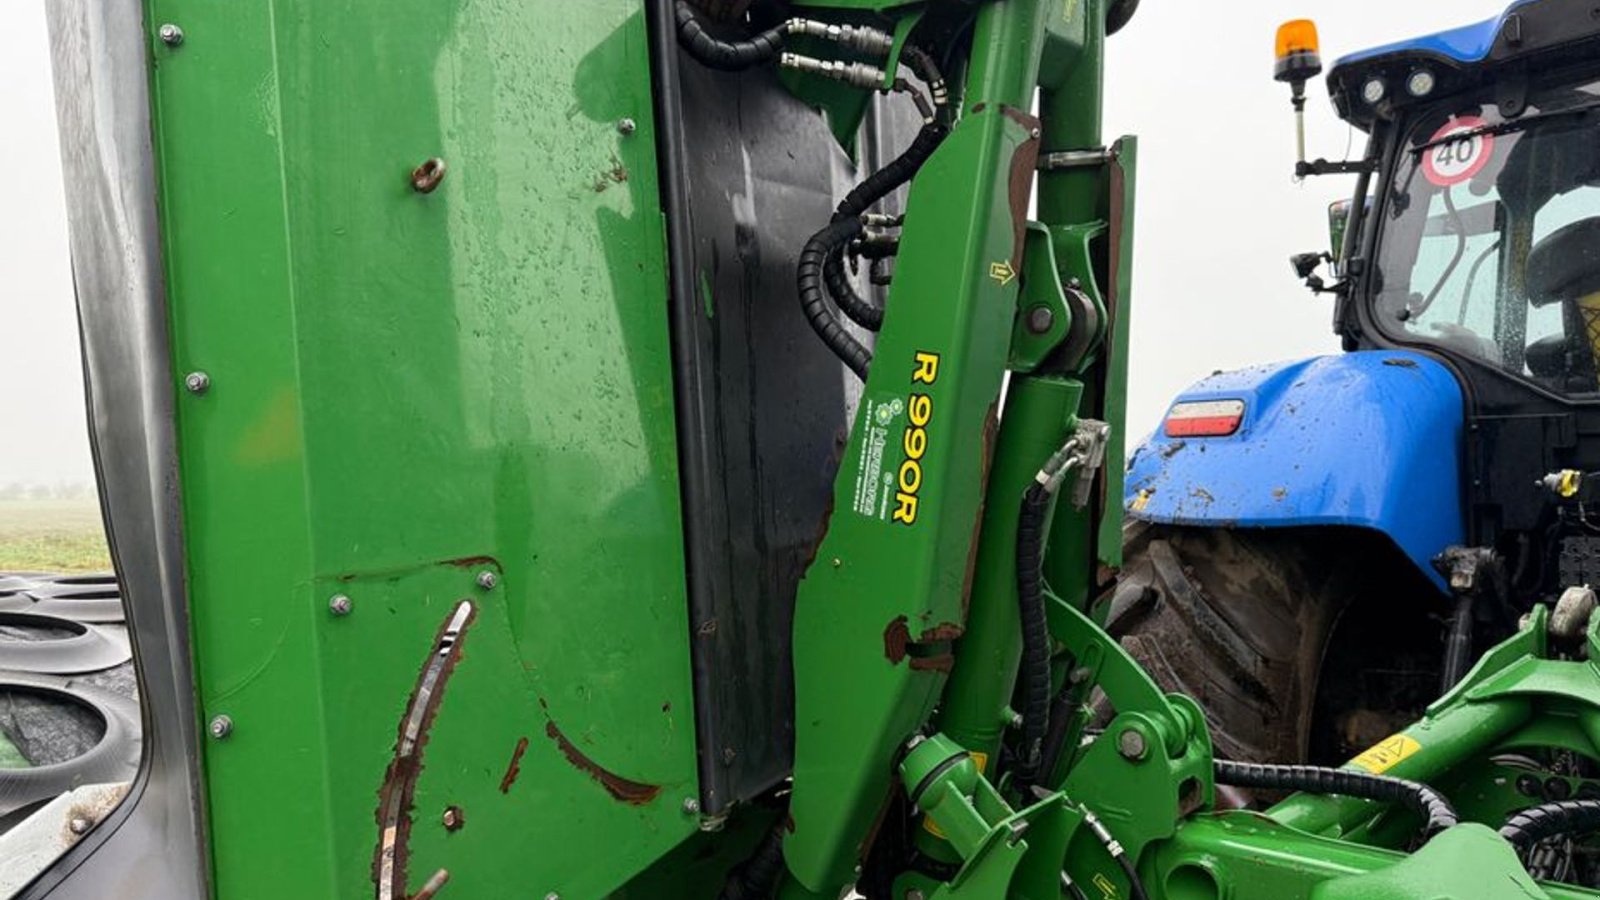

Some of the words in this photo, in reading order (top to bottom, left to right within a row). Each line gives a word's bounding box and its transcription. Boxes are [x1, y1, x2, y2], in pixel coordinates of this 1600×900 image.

[1435, 138, 1474, 165] 40
[913, 351, 940, 384] R
[892, 393, 932, 526] 990R
